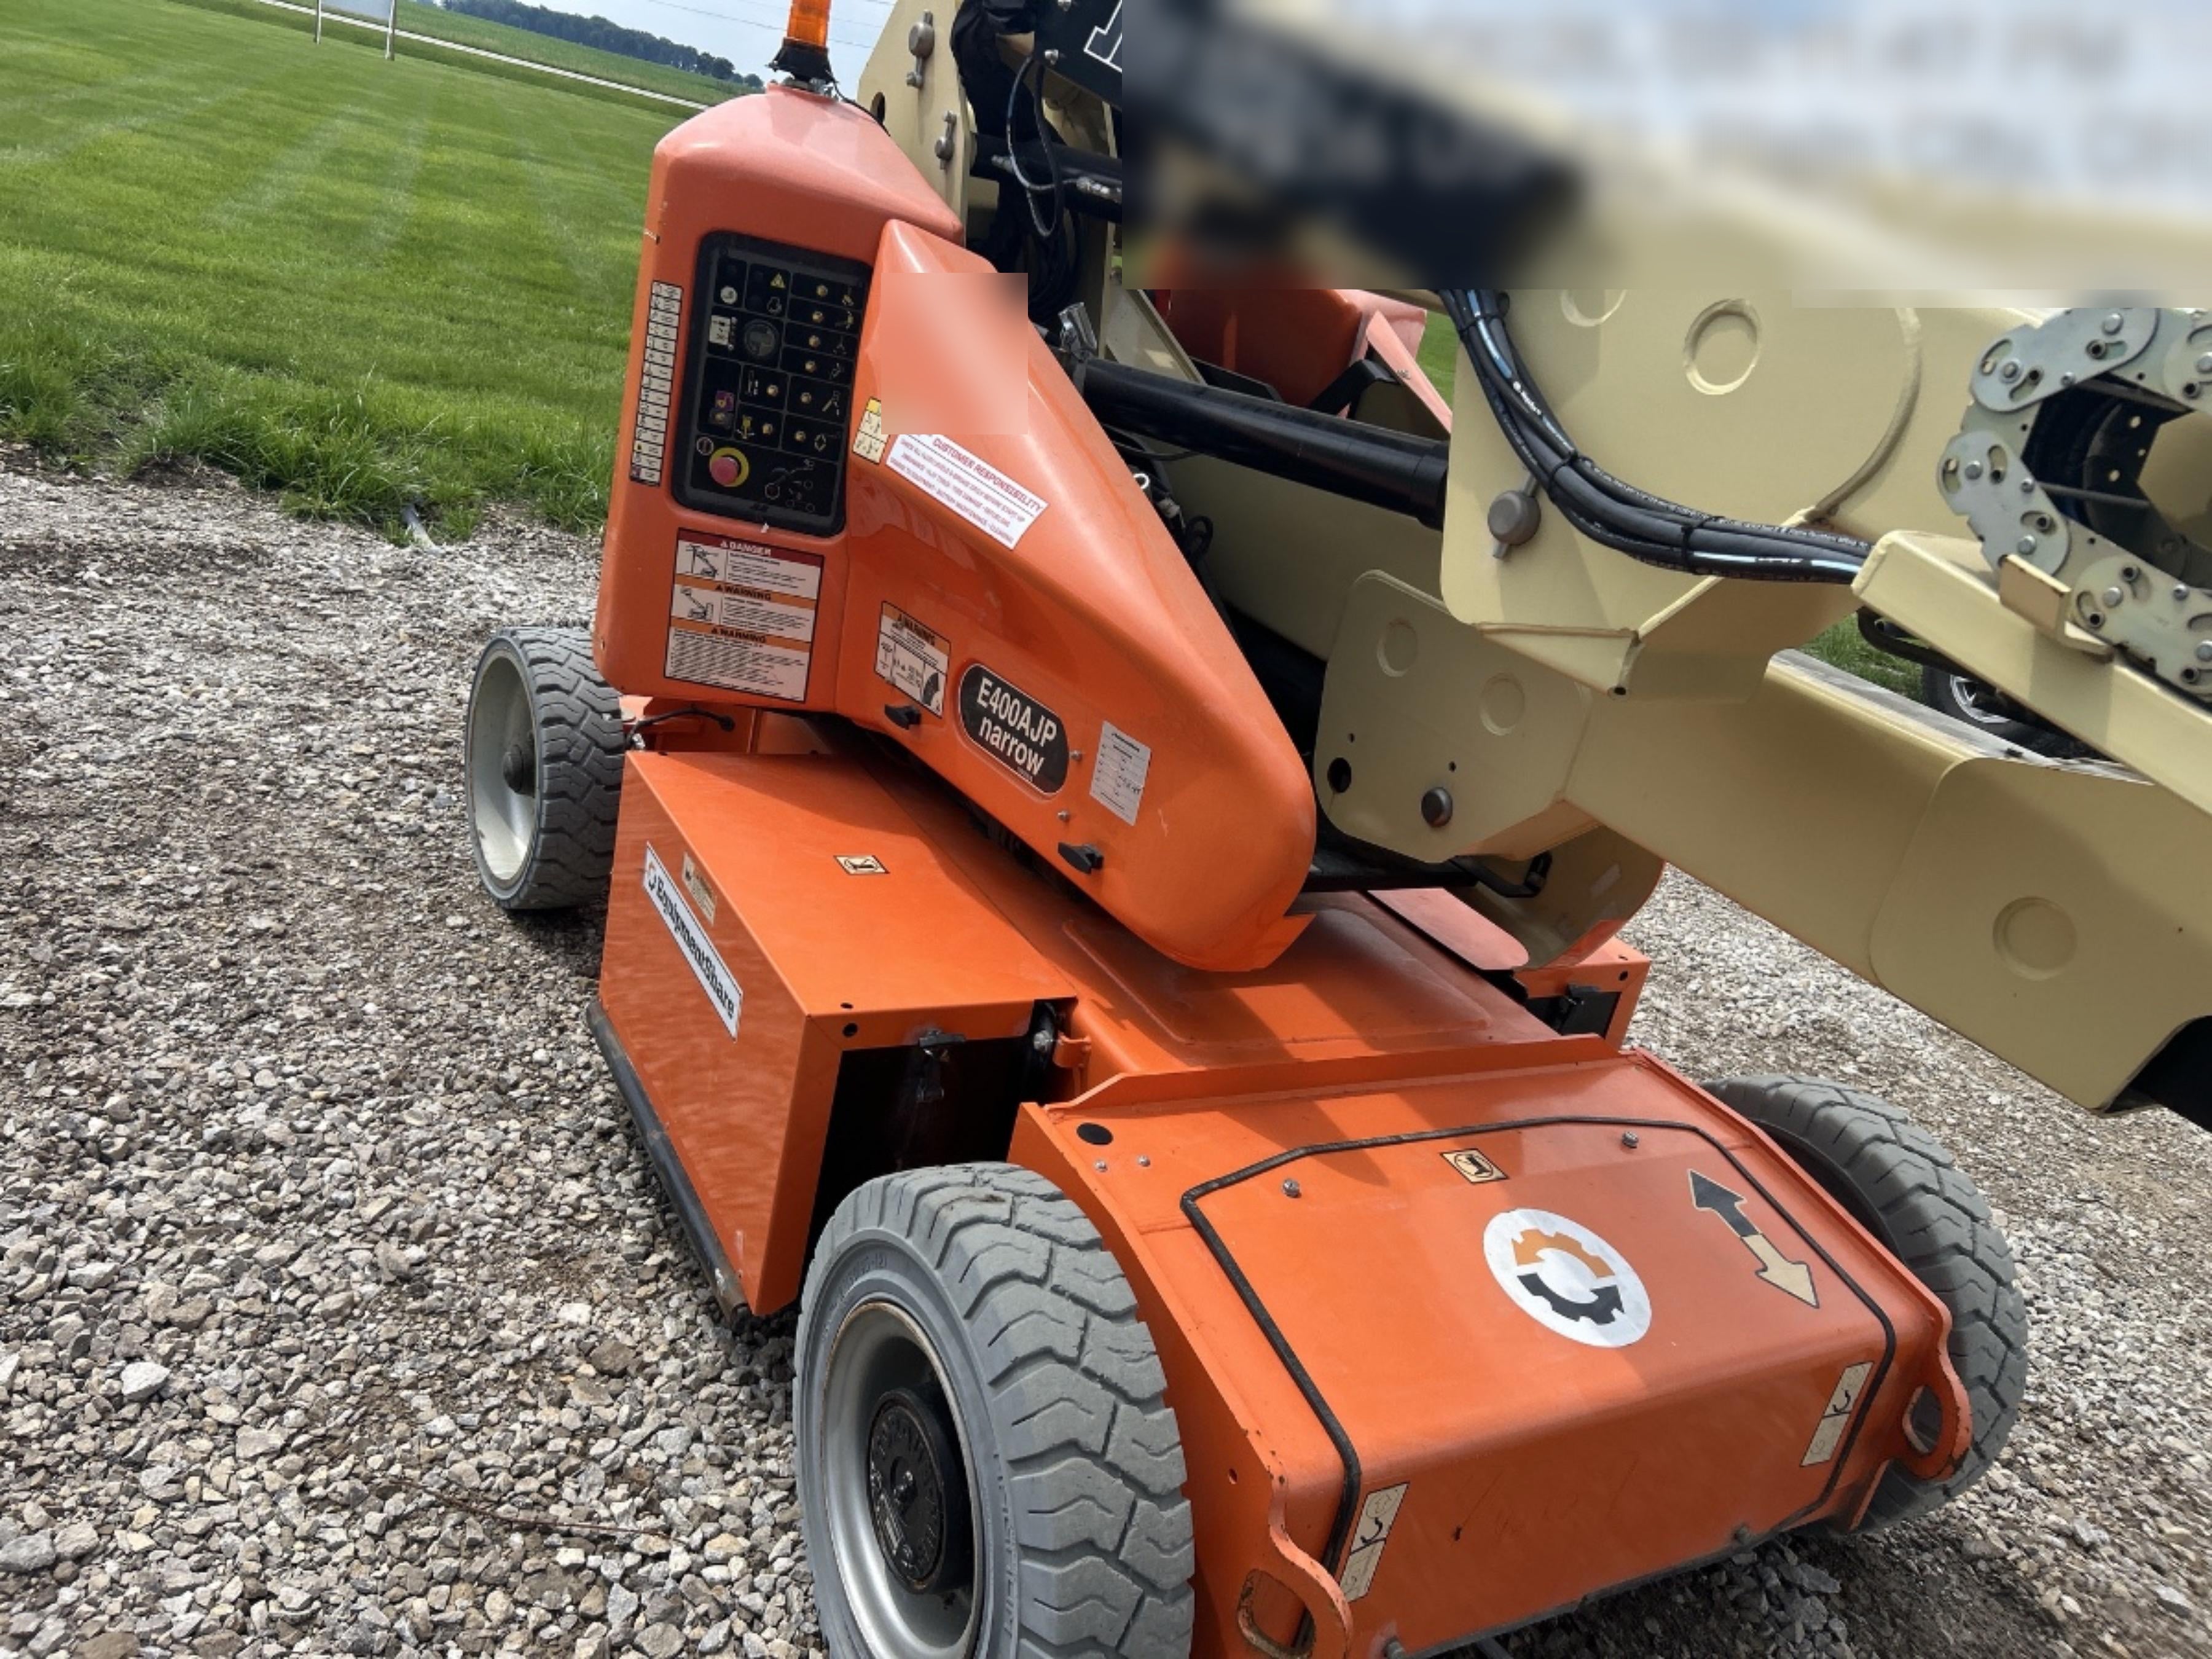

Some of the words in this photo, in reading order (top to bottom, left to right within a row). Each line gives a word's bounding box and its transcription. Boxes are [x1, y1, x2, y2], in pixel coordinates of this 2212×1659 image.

[932, 437, 976, 469] CUSTOMER
[974, 463, 1043, 512] RESPONSIBILITY
[729, 542, 771, 557] DANGER
[724, 584, 772, 602] WARNING
[720, 627, 767, 644] WARNING
[977, 677, 1057, 748] E400AJP
[979, 716, 1045, 775] narrow
[655, 877, 735, 1019] EquipmentShare
